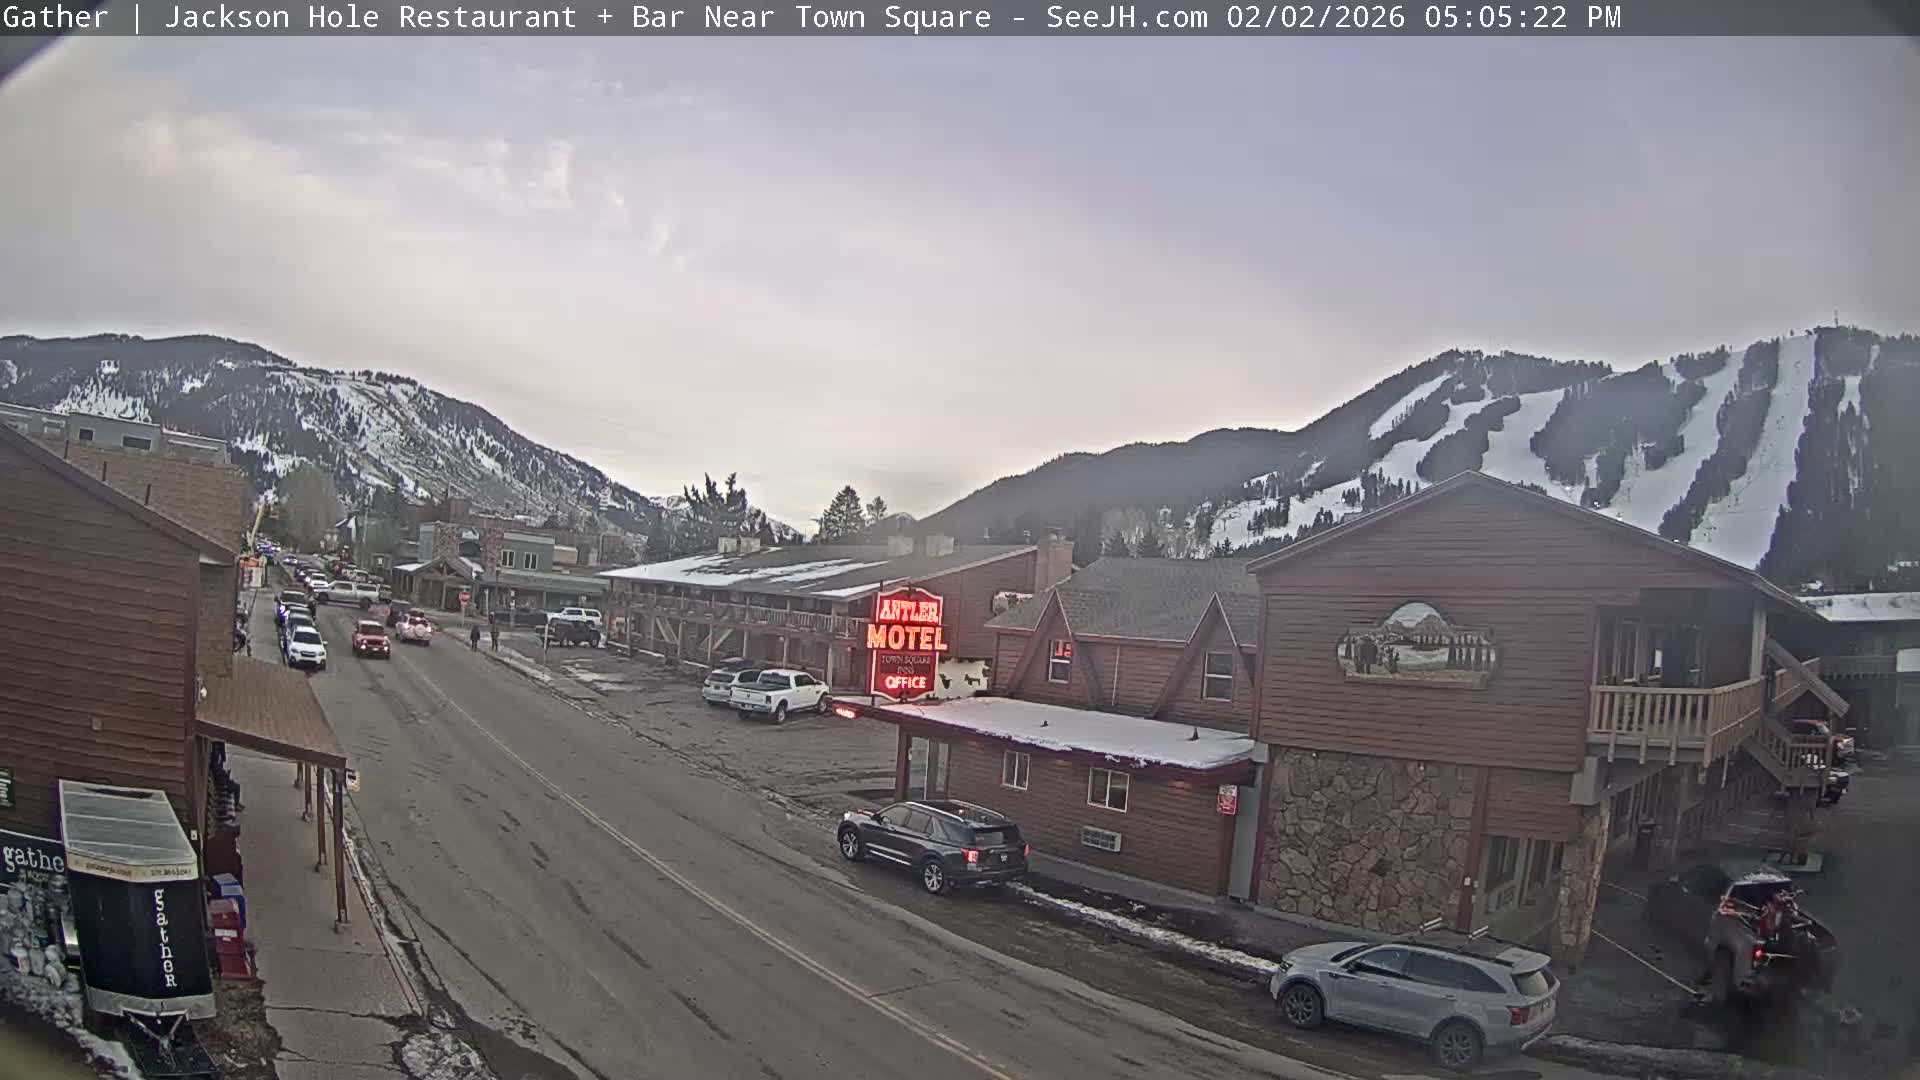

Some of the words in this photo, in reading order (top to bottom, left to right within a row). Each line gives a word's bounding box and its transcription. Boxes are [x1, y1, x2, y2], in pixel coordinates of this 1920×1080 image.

[880, 600, 938, 622] ANTLER
[867, 624, 947, 650] MOTEL
[885, 675, 927, 689] OFFICE
